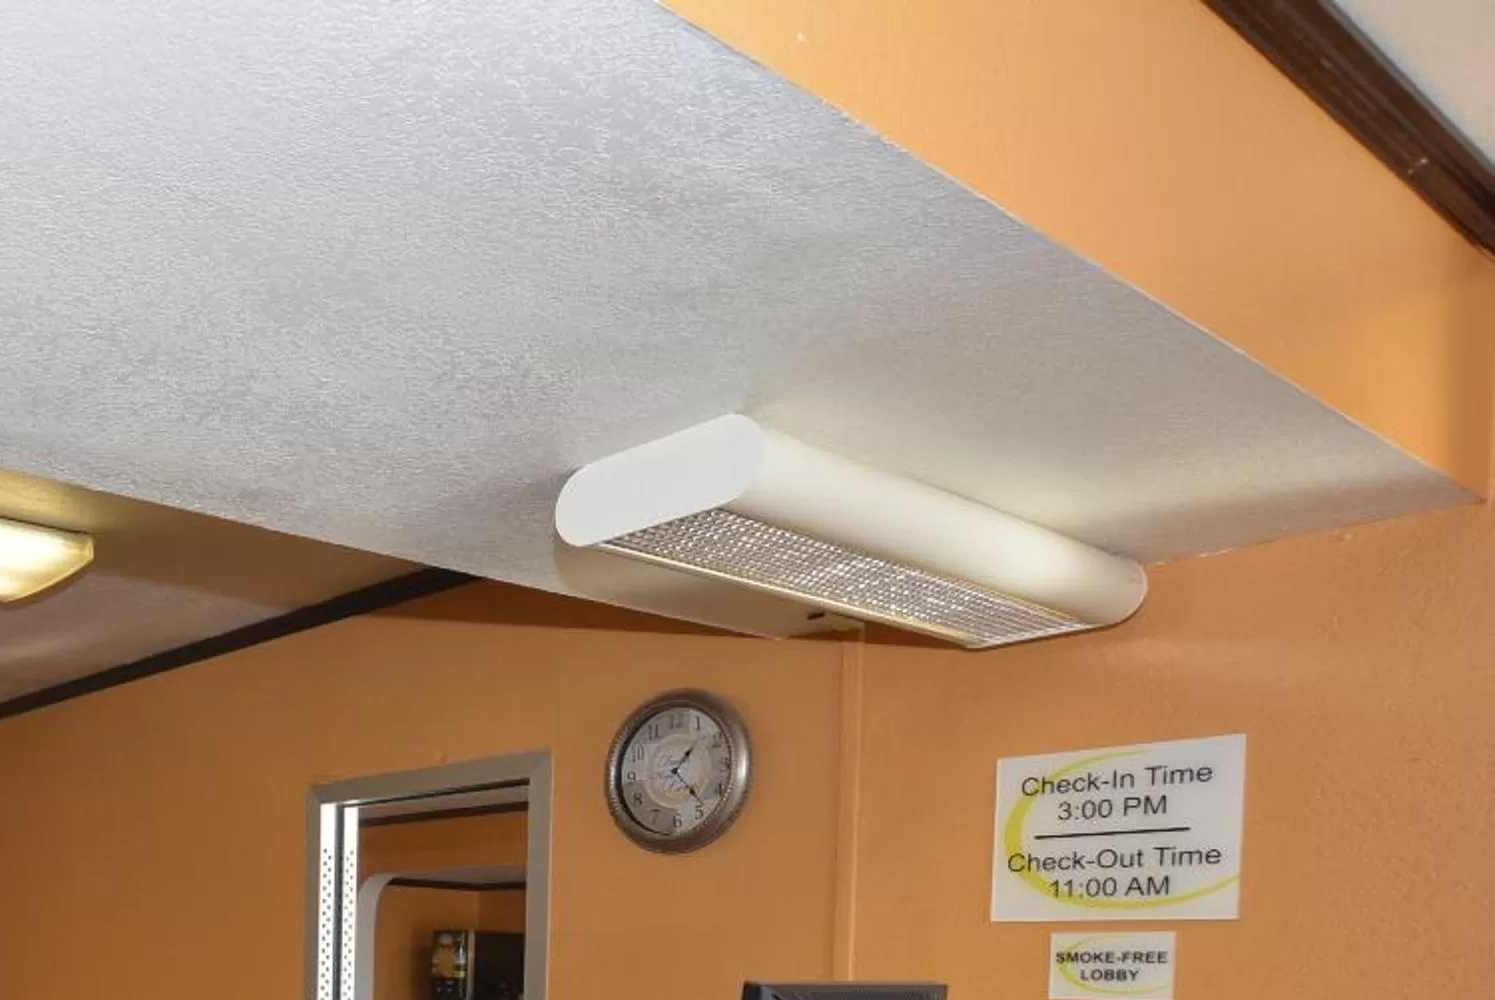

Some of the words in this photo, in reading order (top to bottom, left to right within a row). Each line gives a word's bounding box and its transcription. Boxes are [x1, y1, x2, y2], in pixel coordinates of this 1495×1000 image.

[1021, 768, 1135, 797] Check-In
[1144, 764, 1214, 788] Time
[1057, 799, 1113, 821] 3:00
[1122, 794, 1168, 817] PM
[1008, 848, 1145, 873] Check-Out
[1151, 845, 1222, 867] Time
[1049, 877, 1118, 899] 11:00
[1124, 875, 1171, 896] AM
[1056, 951, 1169, 965] SMOKE-FREE
[1080, 968, 1140, 982] LOBBY
